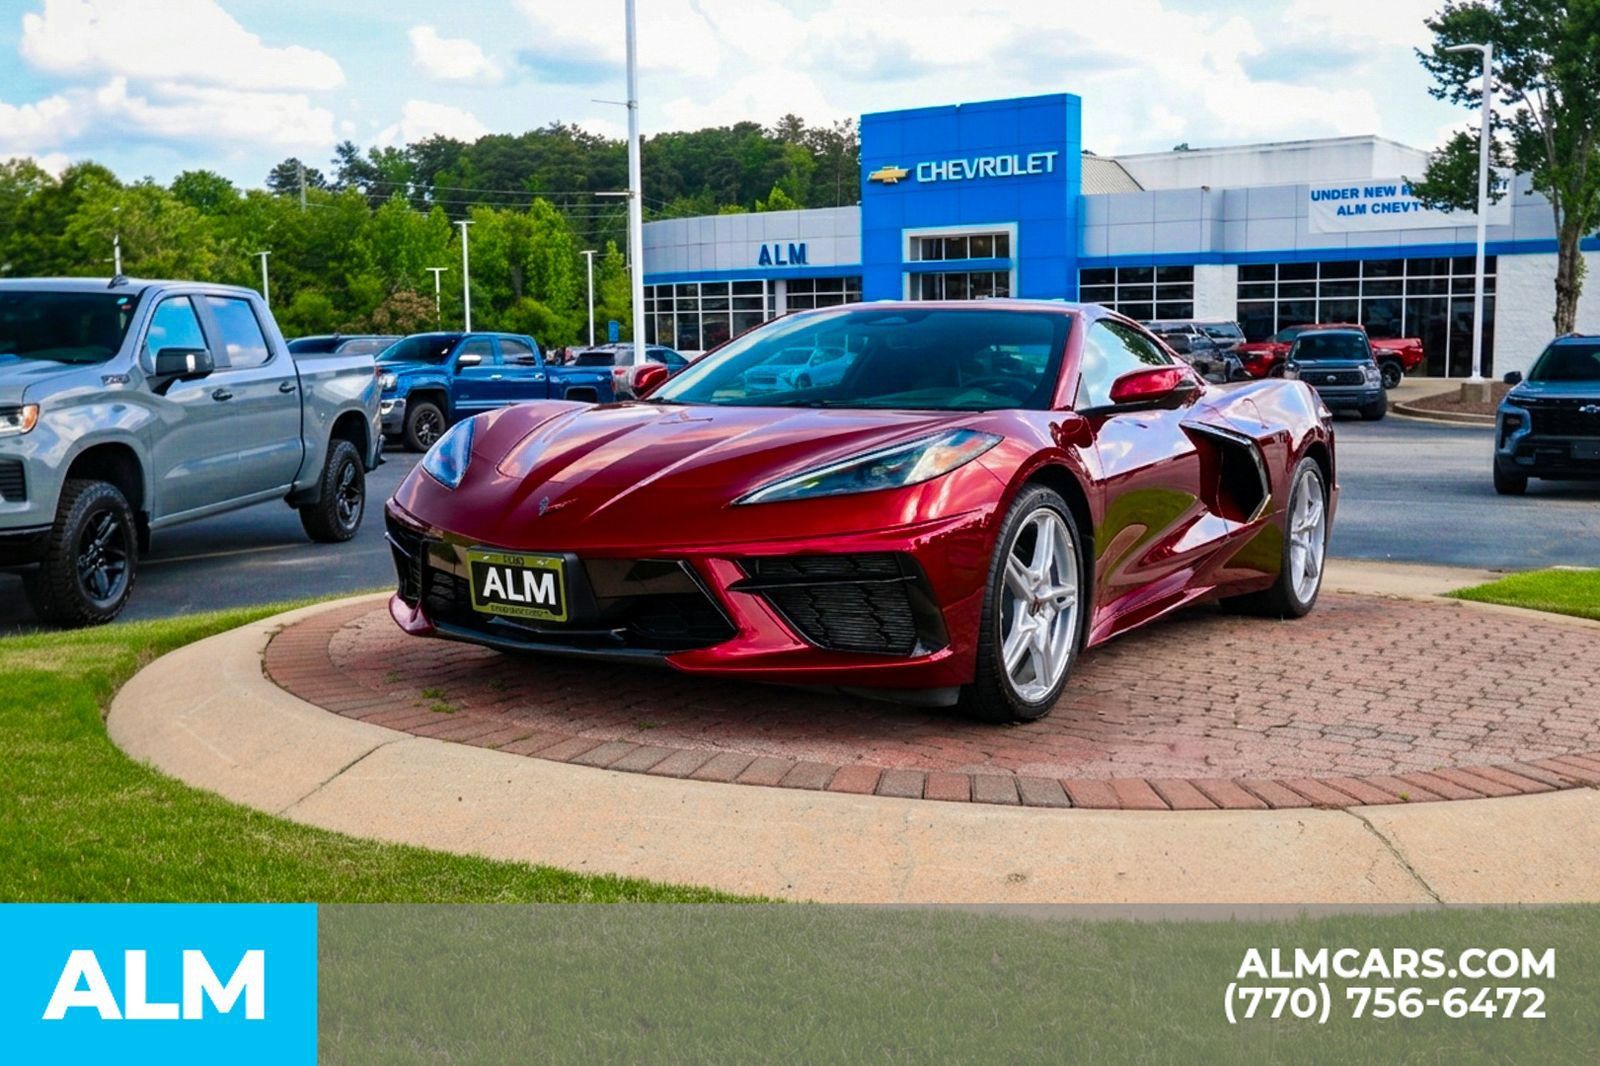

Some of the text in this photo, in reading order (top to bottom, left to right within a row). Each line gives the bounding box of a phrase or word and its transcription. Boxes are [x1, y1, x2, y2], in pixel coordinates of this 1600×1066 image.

[916, 151, 1058, 183] CHEVROLET
[1311, 188, 1359, 201] UNDER
[1364, 186, 1396, 198] NEW
[1337, 204, 1366, 216] ALM
[758, 243, 808, 265] ALM
[482, 566, 556, 605] ALM
